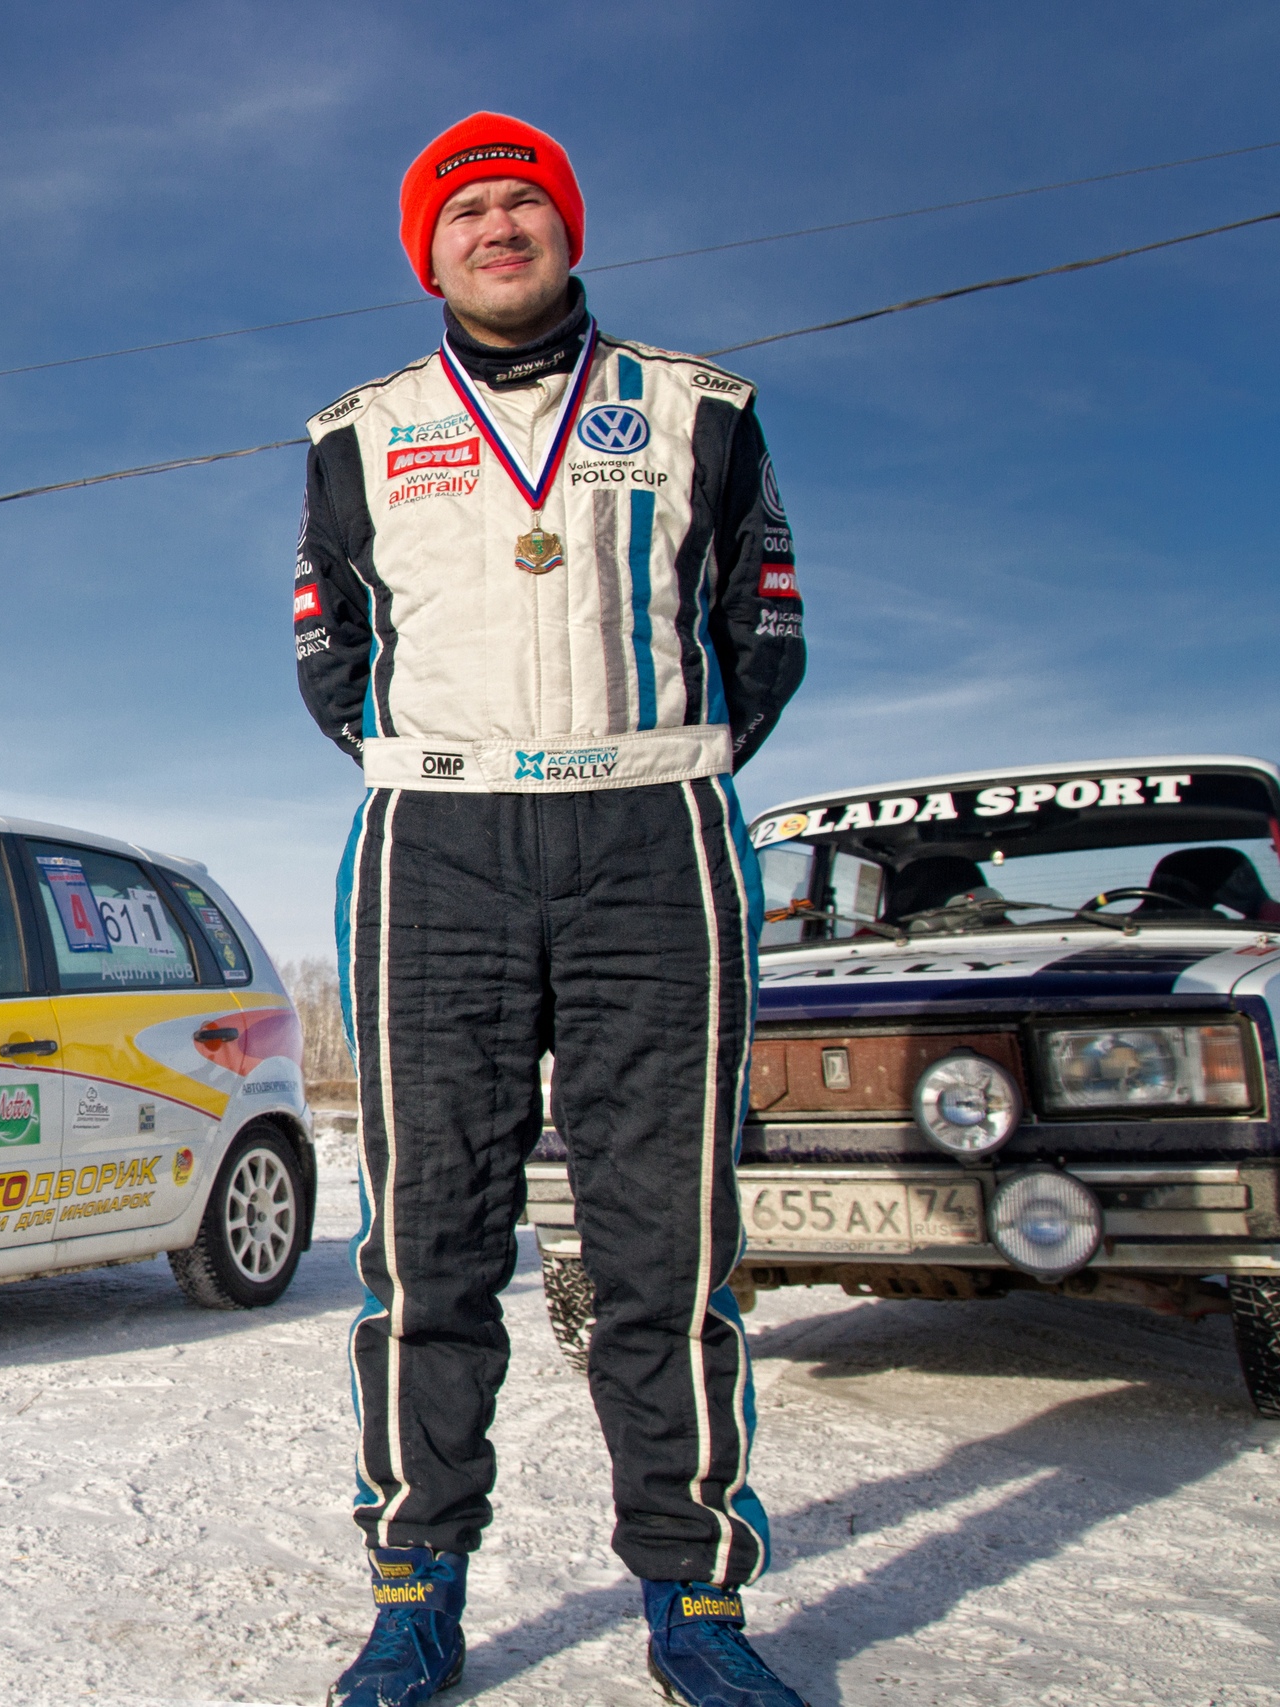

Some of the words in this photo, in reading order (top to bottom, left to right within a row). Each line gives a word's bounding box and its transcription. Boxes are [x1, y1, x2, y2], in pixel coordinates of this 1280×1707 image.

[692, 374, 743, 391] OMP
[319, 397, 361, 421] OMP
[416, 422, 477, 442] RALLY
[417, 414, 470, 433] ACADEM
[393, 445, 473, 471] MOTUL
[569, 460, 635, 470] Volkswagen
[571, 469, 626, 486] POLO
[631, 469, 668, 486] CUP
[389, 476, 479, 504] almrally
[389, 501, 402, 510] ALL
[404, 494, 432, 504] ABOUT
[764, 536, 789, 552] OLO
[295, 592, 315, 613] OTUL
[299, 635, 331, 657] RALLY
[422, 756, 465, 775] OMP
[548, 752, 618, 766] ACADEMY
[546, 763, 617, 780] RALLY
[801, 792, 958, 837] LADA
[974, 775, 1191, 817] SPORT
[70, 893, 95, 937] 4
[759, 959, 1029, 982] ALLY
[13, 1208, 56, 1232] ДЛЯ
[59, 1191, 155, 1221] ИНОМАРОК
[915, 1188, 966, 1222] 74
[914, 1223, 950, 1237] RUS
